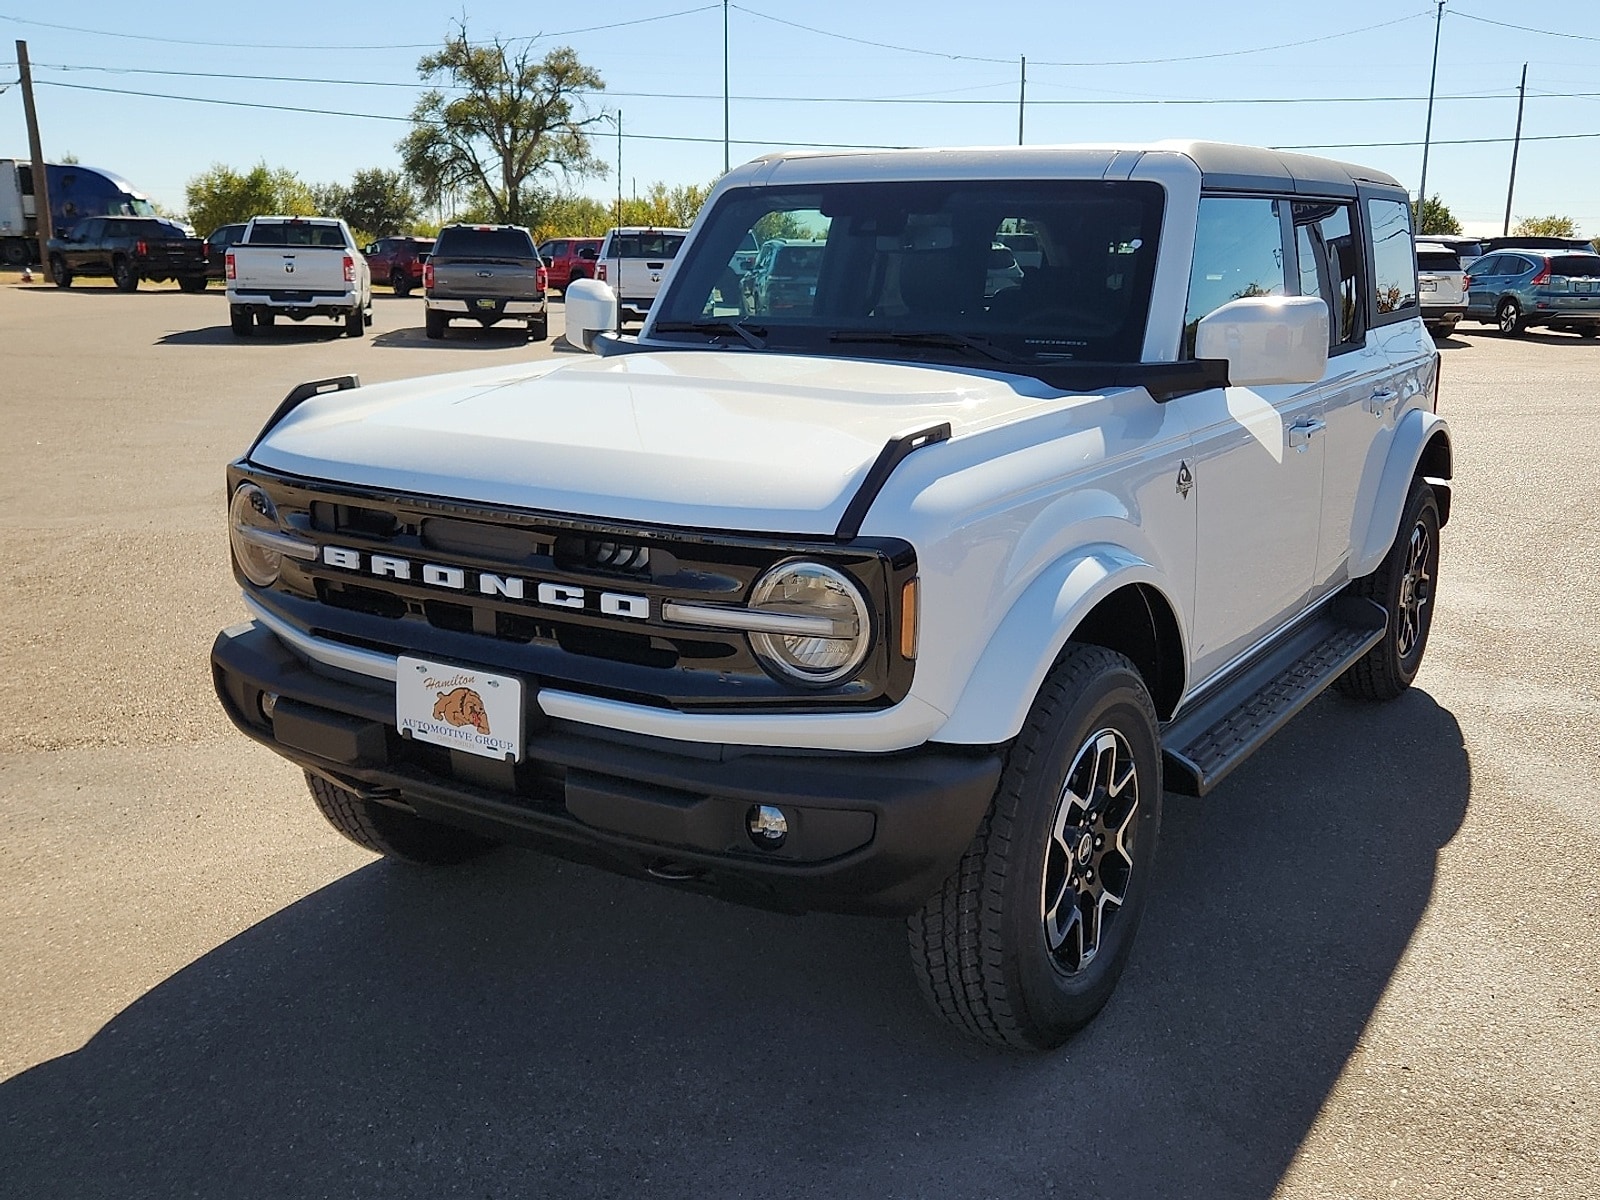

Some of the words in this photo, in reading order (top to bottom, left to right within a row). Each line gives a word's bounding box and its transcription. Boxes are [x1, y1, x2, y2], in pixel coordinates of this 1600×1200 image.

[323, 545, 650, 619] BRONCO
[423, 674, 475, 690] Hamilton
[402, 718, 473, 742] AUTOMOTIVE
[475, 735, 514, 750] GROUP
